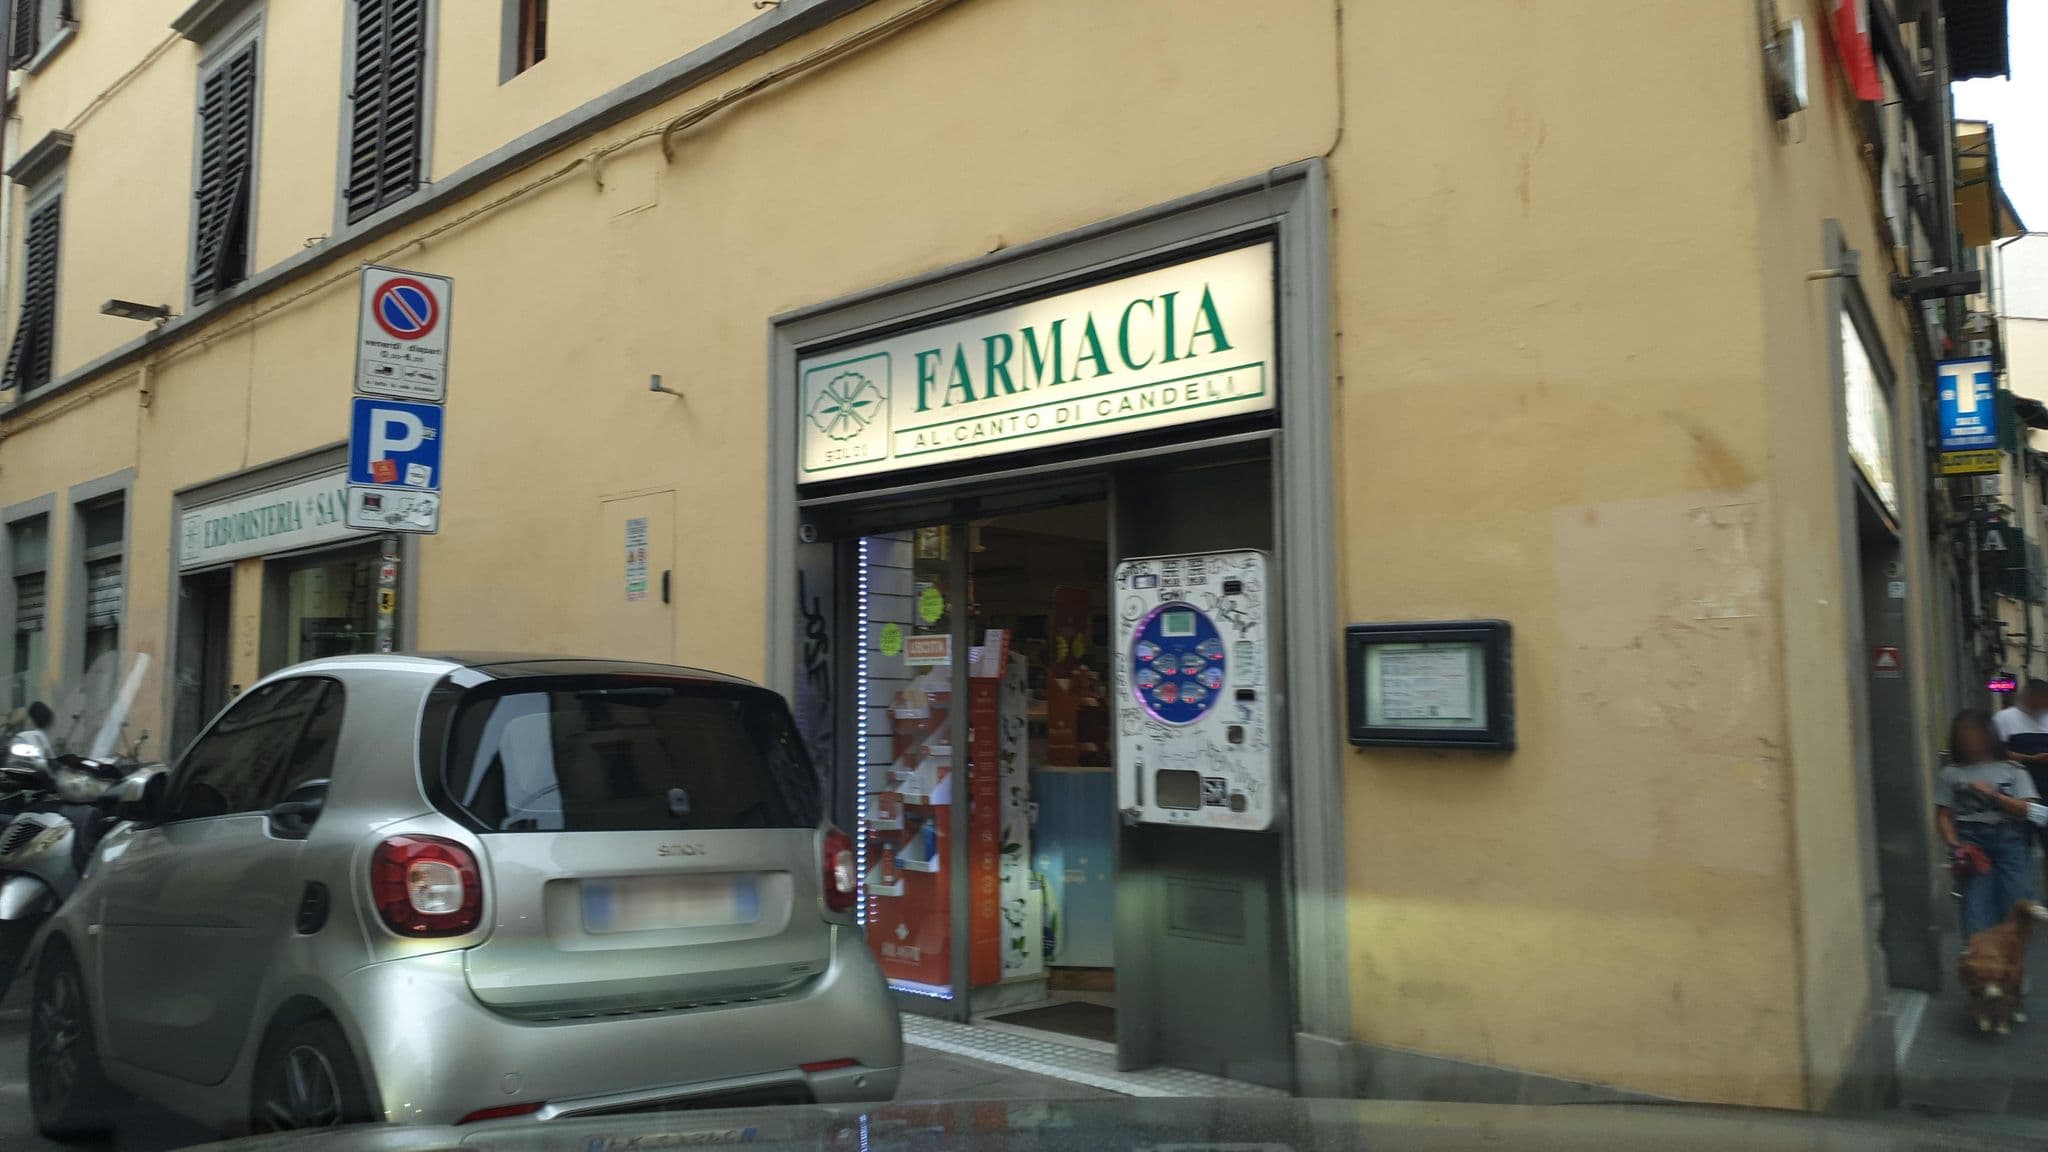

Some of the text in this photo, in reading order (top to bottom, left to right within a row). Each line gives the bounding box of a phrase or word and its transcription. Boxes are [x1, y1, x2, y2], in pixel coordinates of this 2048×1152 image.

[914, 284, 1235, 413] FARMACIA
[367, 408, 424, 475] P
[914, 375, 1235, 448] AL CANTO DI CANDELI
[203, 501, 302, 549] ERBORISTERIA
